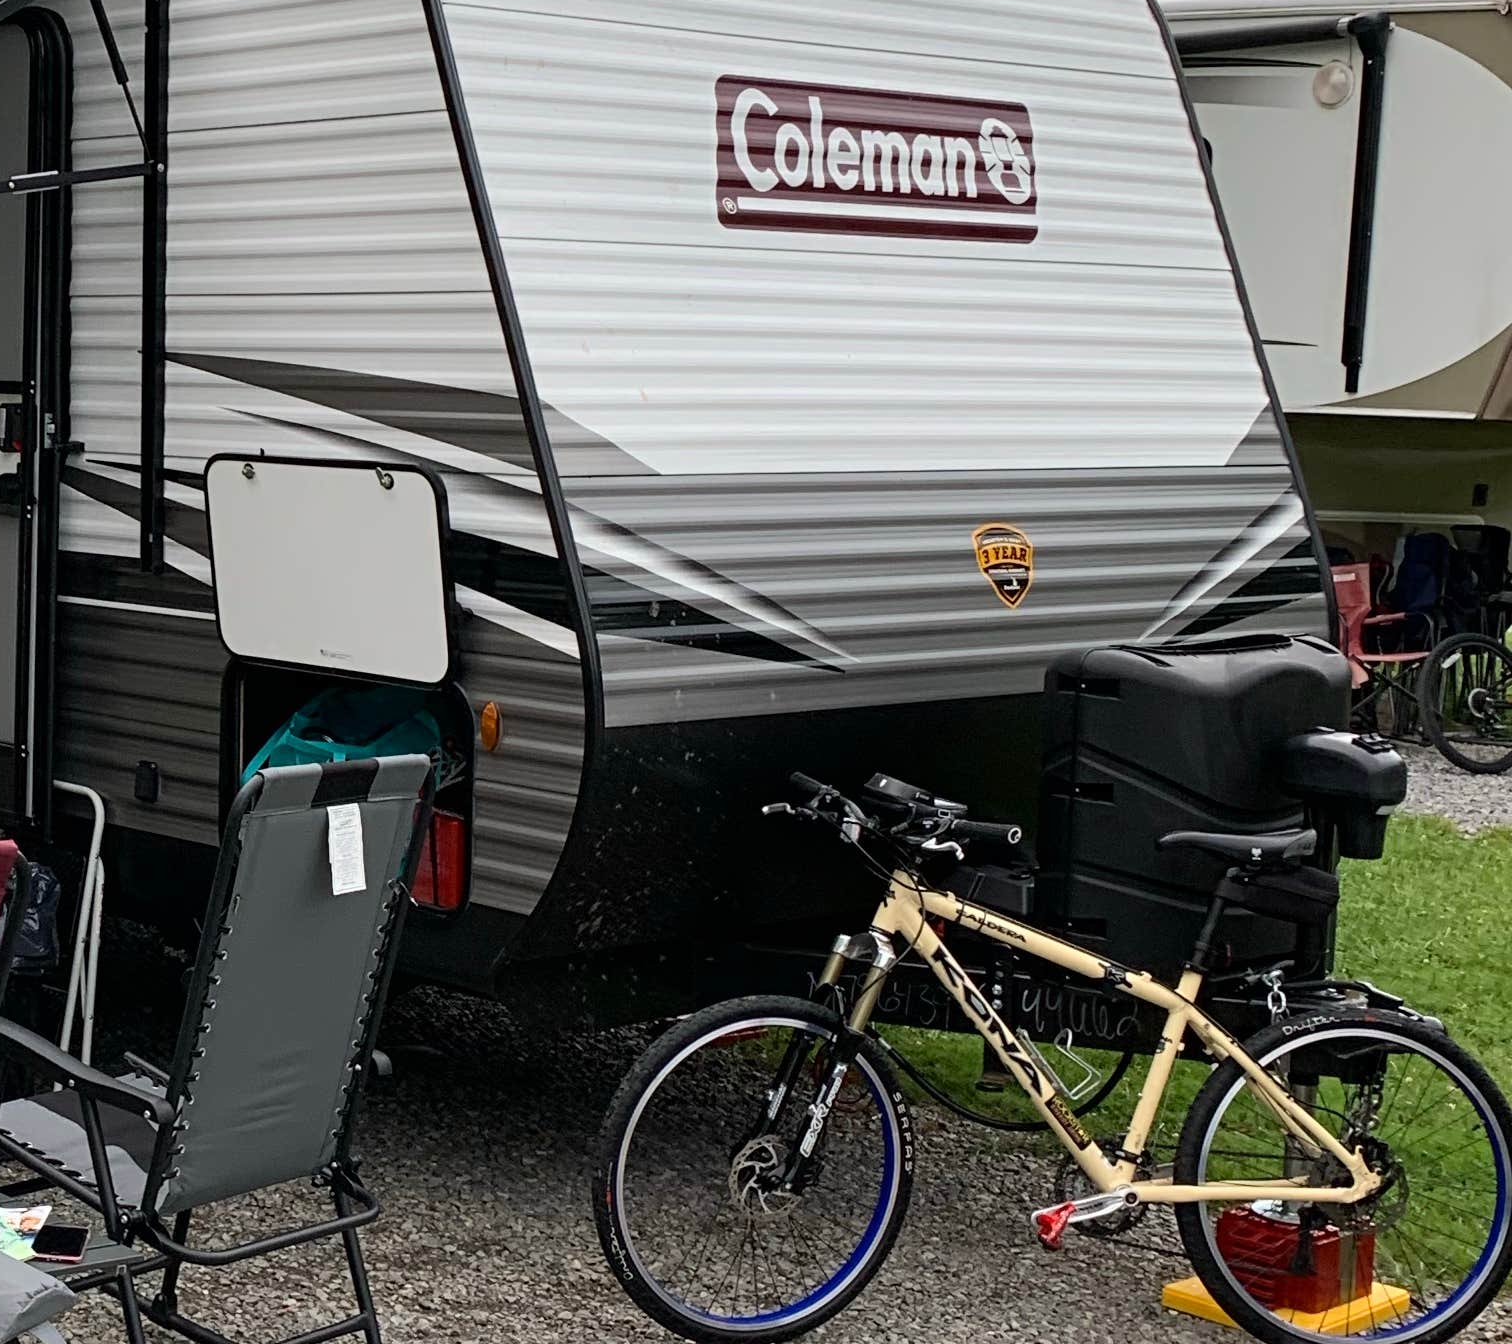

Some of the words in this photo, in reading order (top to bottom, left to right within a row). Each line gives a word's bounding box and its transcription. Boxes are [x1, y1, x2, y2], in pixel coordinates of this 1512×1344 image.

[730, 87, 978, 198] Coleman
[982, 549, 990, 564] 3
[993, 545, 1027, 562] YEAR
[930, 945, 1043, 1097] KONA
[1282, 1015, 1341, 1036] Drifter
[892, 1091, 913, 1173] SERFAS
